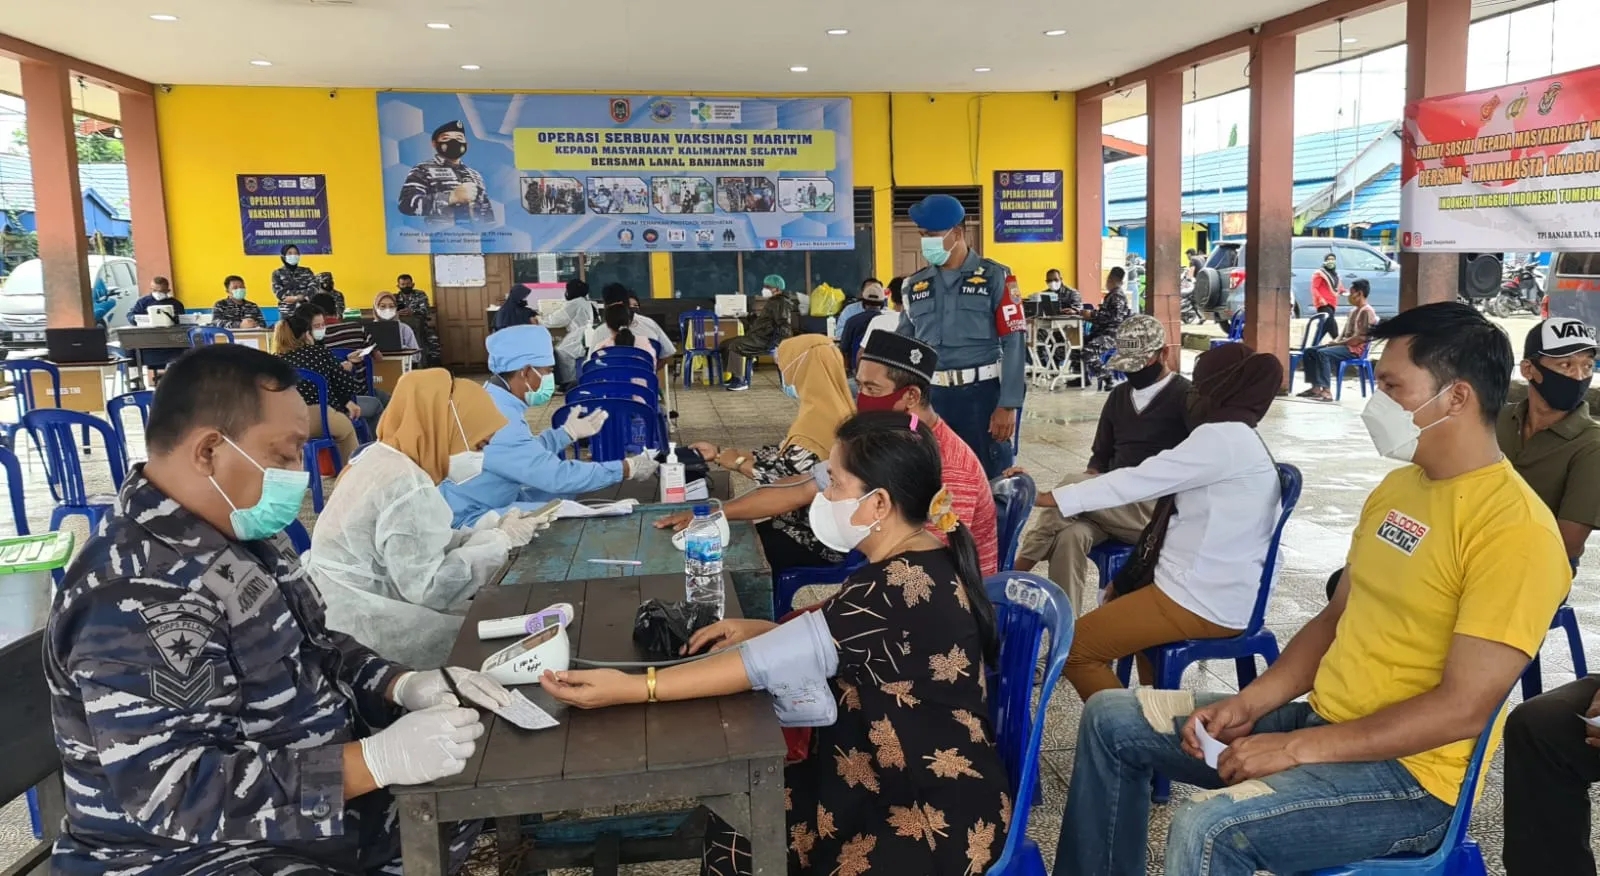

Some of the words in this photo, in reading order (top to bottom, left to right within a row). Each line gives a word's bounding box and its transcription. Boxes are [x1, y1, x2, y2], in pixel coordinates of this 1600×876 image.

[538, 132, 600, 143] OPERASI
[605, 133, 670, 144] SERBUAN
[675, 133, 748, 144] VAKSINASI
[753, 134, 813, 145] MARITIM
[1445, 139, 1475, 158] SOSIAL
[1476, 133, 1512, 154] KEPADA
[1514, 121, 1588, 149] MASYARAKAT
[555, 146, 598, 154] KEPADA
[602, 146, 674, 155] MASYARAKAT
[678, 147, 747, 156] KALIMANTAN
[750, 147, 798, 156] SELATAN
[591, 157, 645, 166] BERSAMA
[650, 158, 685, 166] LANAL
[689, 158, 765, 167] BANJARMASIN
[1418, 167, 1462, 187] BERSAMA
[250, 196, 280, 206] OPERASI
[1439, 195, 1473, 210] INDONESIA
[1475, 193, 1509, 208] TANGGUH
[1510, 189, 1557, 206] INDONESIA
[1559, 186, 1600, 203] TUMBUH
[248, 209, 287, 219] VAKSINASI
[289, 209, 321, 218] MARITIM
[1548, 231, 1571, 239] BANJAR
[912, 290, 930, 300] YUDI
[977, 287, 989, 295] AL
[1386, 511, 1427, 537] BLOODS
[1381, 522, 1418, 551] YOUTH
[156, 622, 180, 634] KORPS
